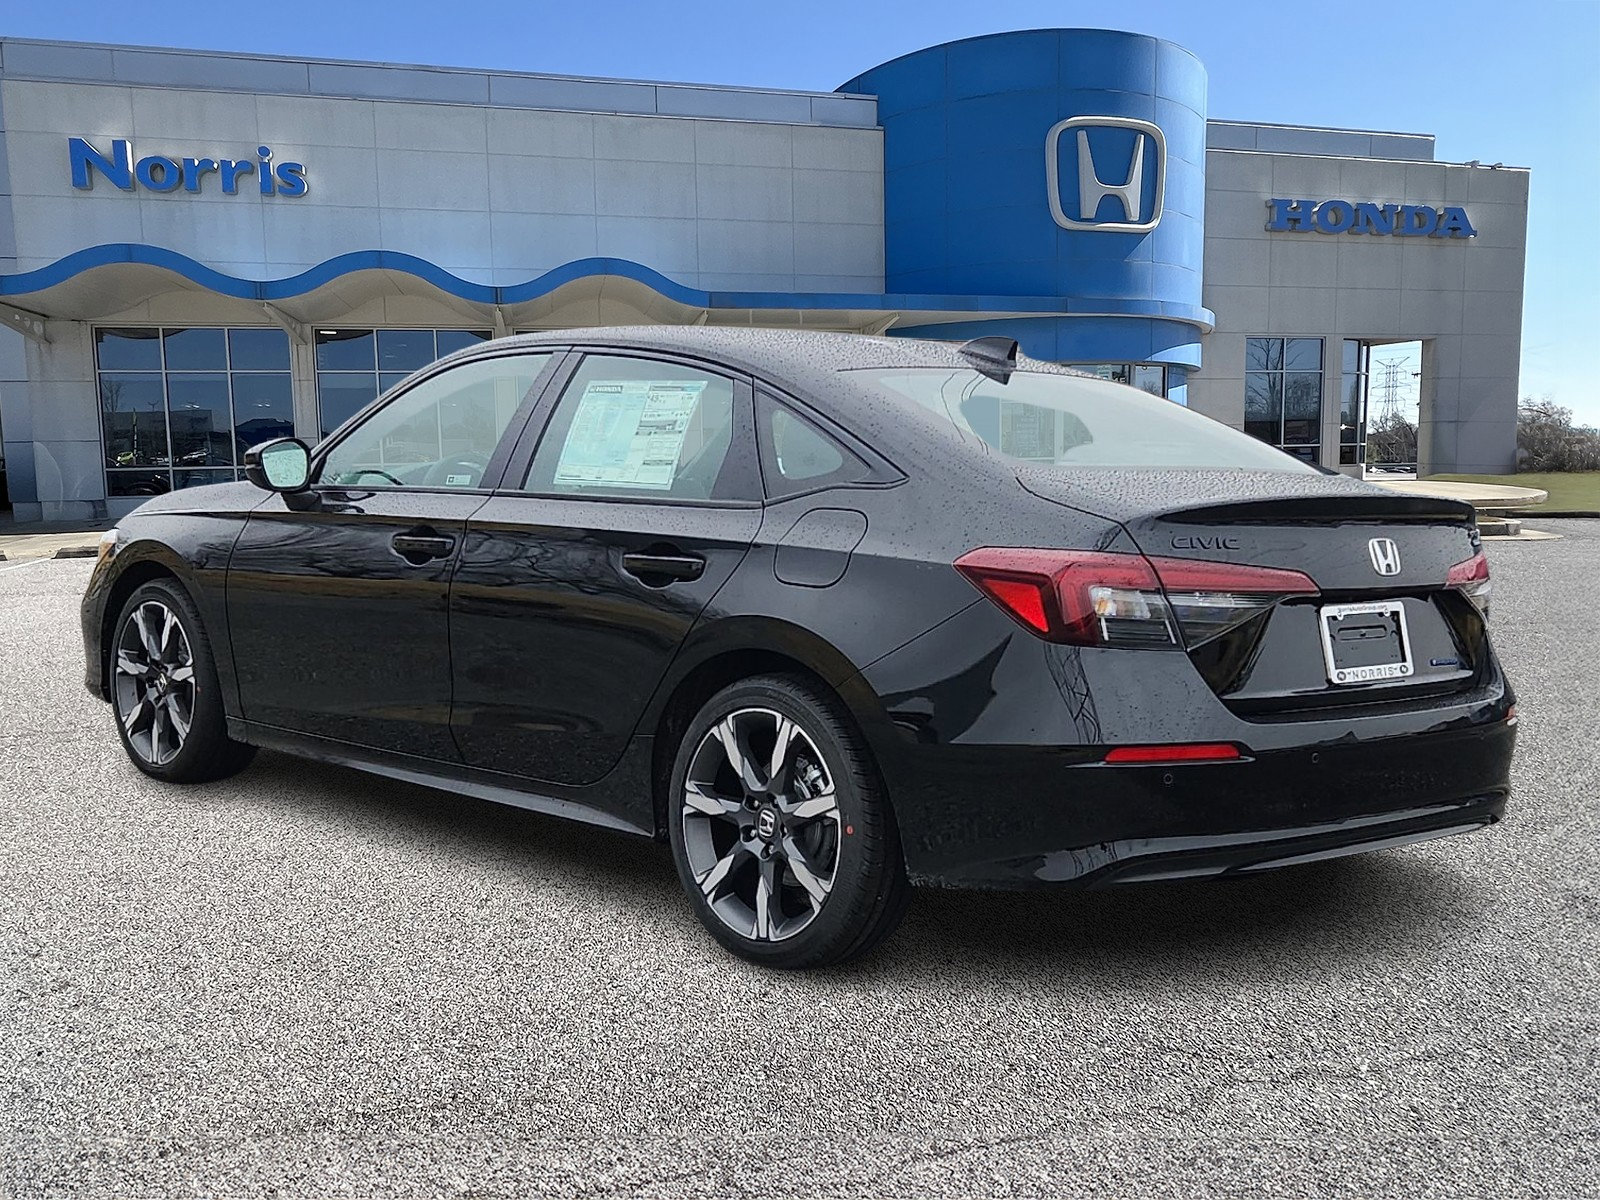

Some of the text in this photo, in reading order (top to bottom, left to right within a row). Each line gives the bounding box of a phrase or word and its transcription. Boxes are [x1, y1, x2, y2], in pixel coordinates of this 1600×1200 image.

[68, 137, 308, 197] Norris
[1265, 198, 1478, 239] HONDA
[1170, 536, 1240, 550] CIVIC
[1352, 666, 1395, 680] NORRIS
